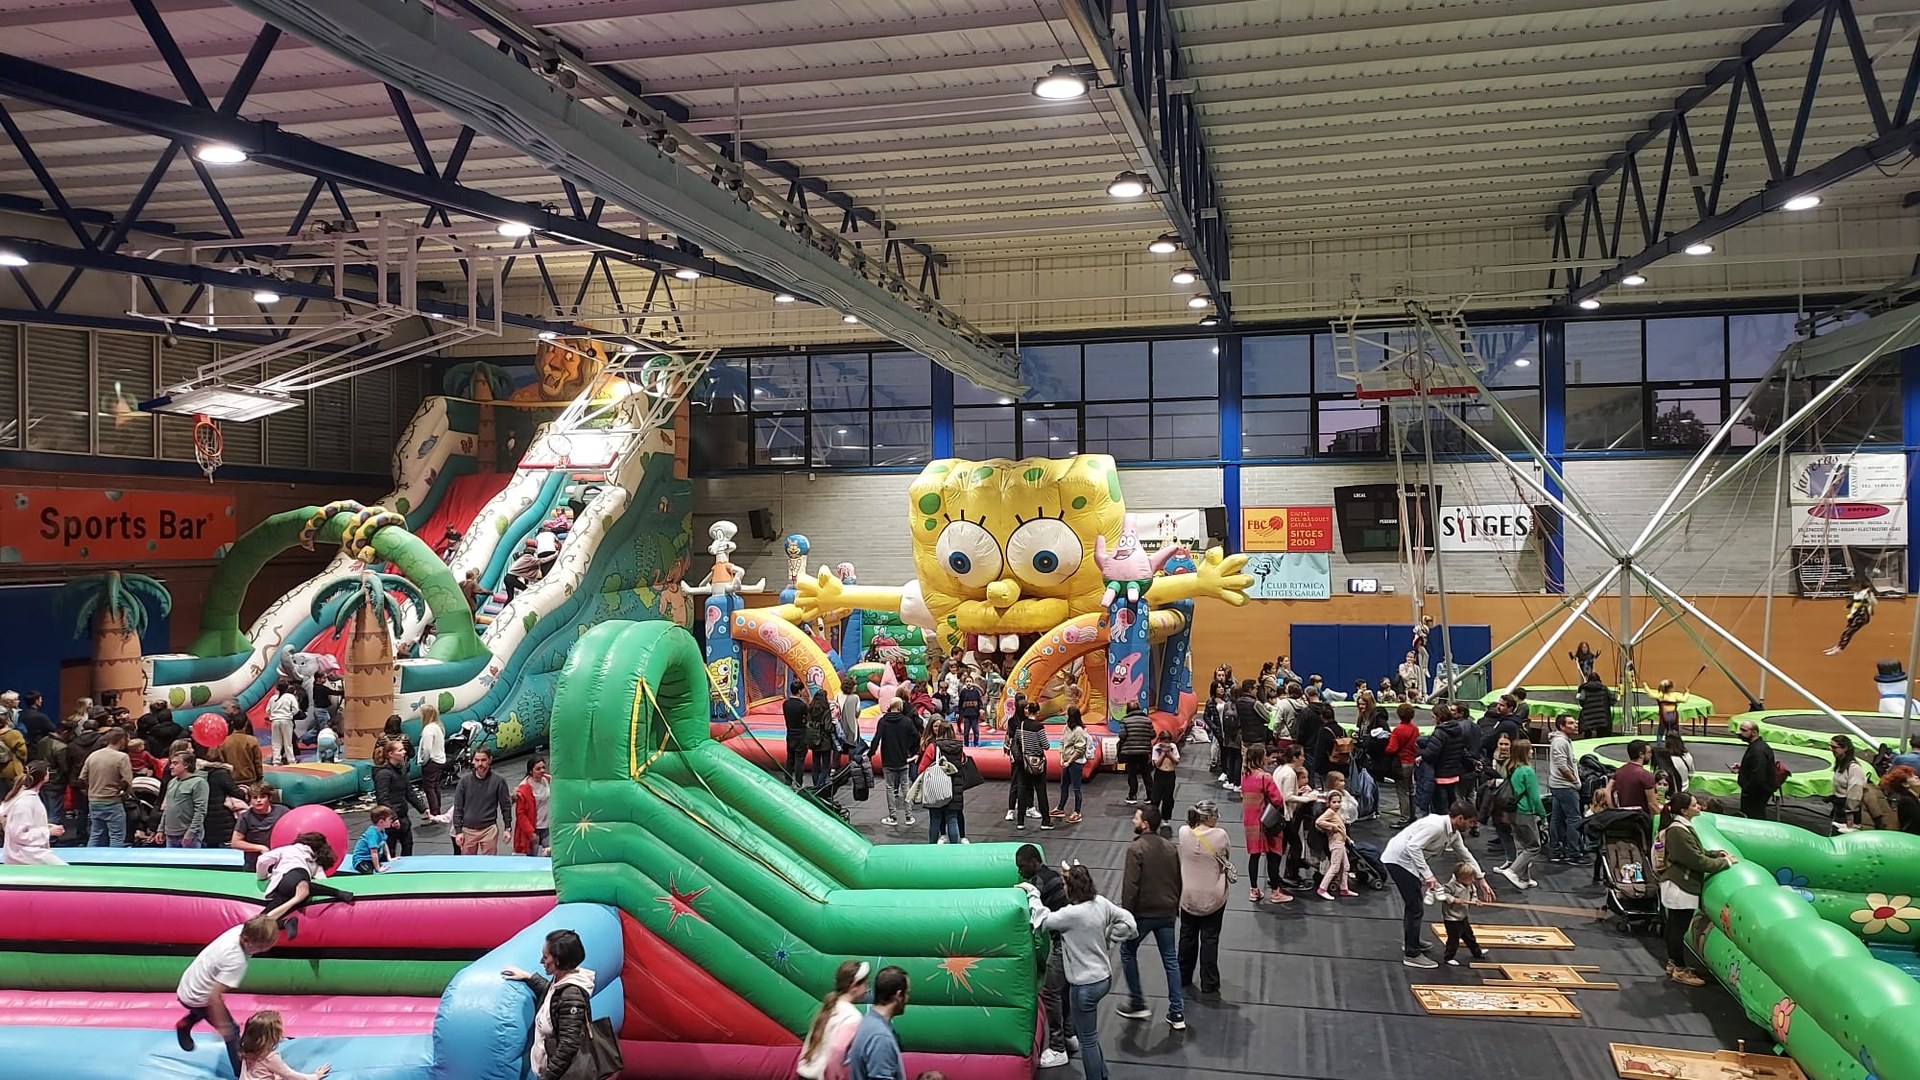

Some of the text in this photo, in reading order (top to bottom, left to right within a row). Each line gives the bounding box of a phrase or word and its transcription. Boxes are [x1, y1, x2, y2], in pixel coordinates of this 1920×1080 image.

[1793, 455, 1841, 498] farreras
[40, 507, 208, 547] Sports Bar
[1247, 520, 1269, 530] FBC
[1290, 530, 1324, 538] SITGES
[1442, 510, 1528, 540] SITGES
[1290, 538, 1316, 546] 2008
